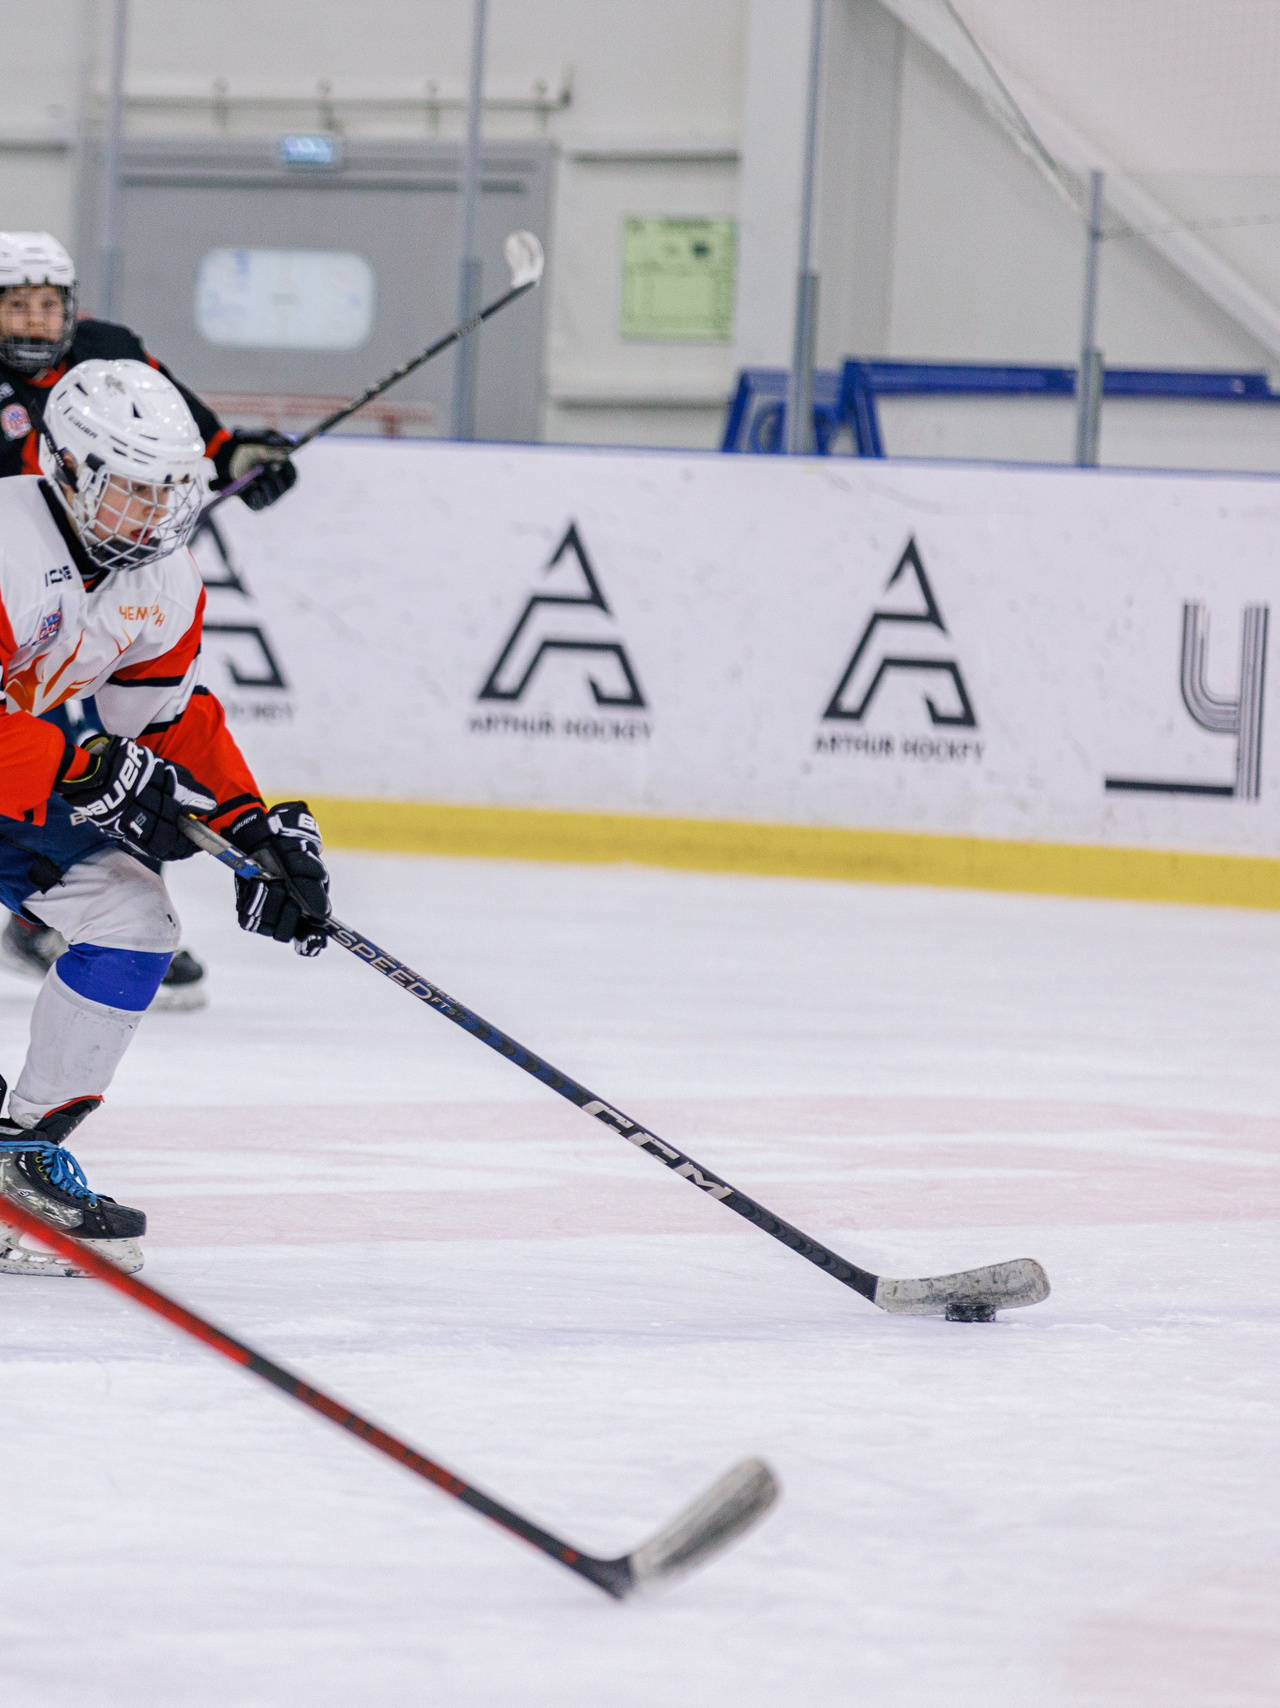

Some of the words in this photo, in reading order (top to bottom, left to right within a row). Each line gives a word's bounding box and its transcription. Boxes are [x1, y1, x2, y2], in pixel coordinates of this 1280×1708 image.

[467, 713, 555, 736] ARTHUR
[814, 732, 894, 758] ARTHUR
[322, 919, 433, 1000] TSPEED
[581, 1100, 734, 1200] CCM
